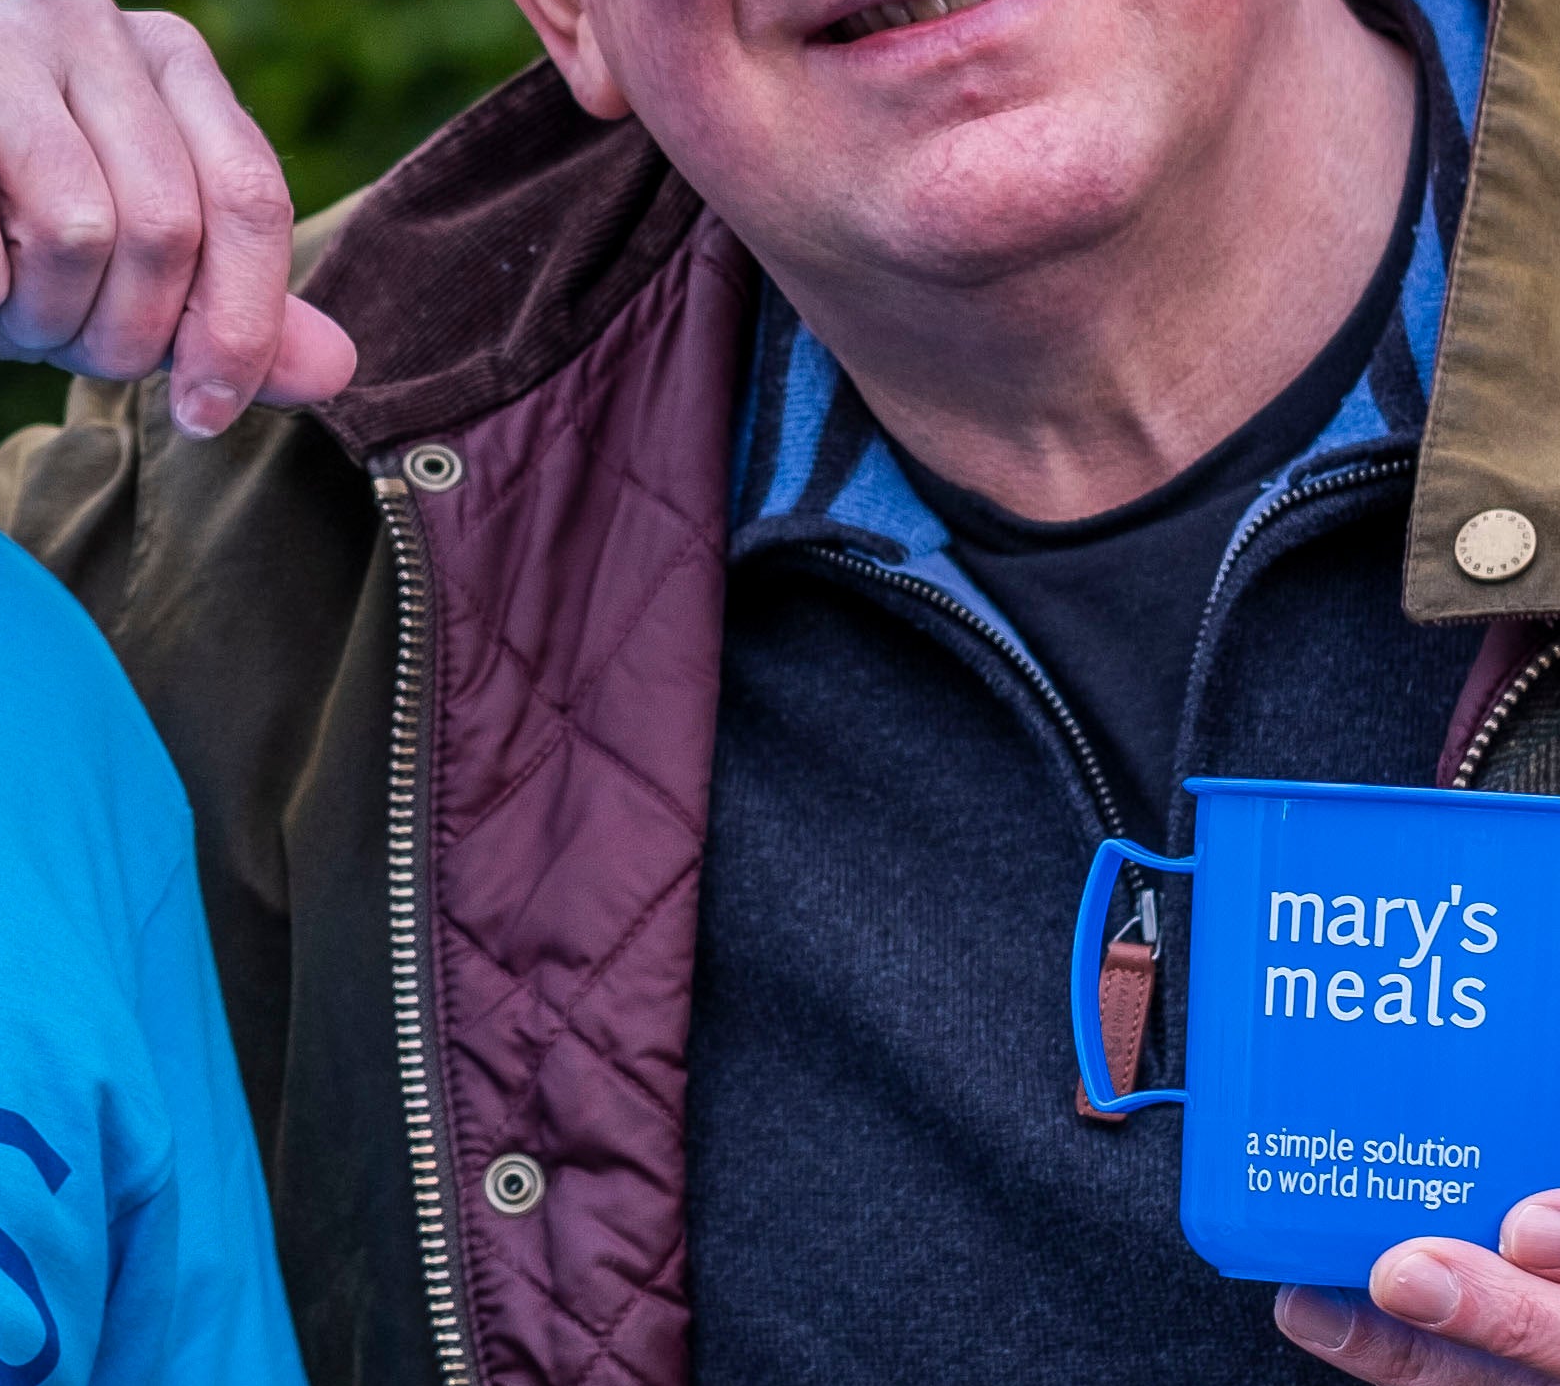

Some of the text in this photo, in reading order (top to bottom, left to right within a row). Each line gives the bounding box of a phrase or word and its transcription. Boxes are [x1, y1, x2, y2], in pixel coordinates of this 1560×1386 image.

[1269, 884, 1498, 968] mary's
[1264, 955, 1488, 1029] meals
[1246, 1127, 1481, 1170] a simple solution
[1247, 1162, 1476, 1210] to world hunger
